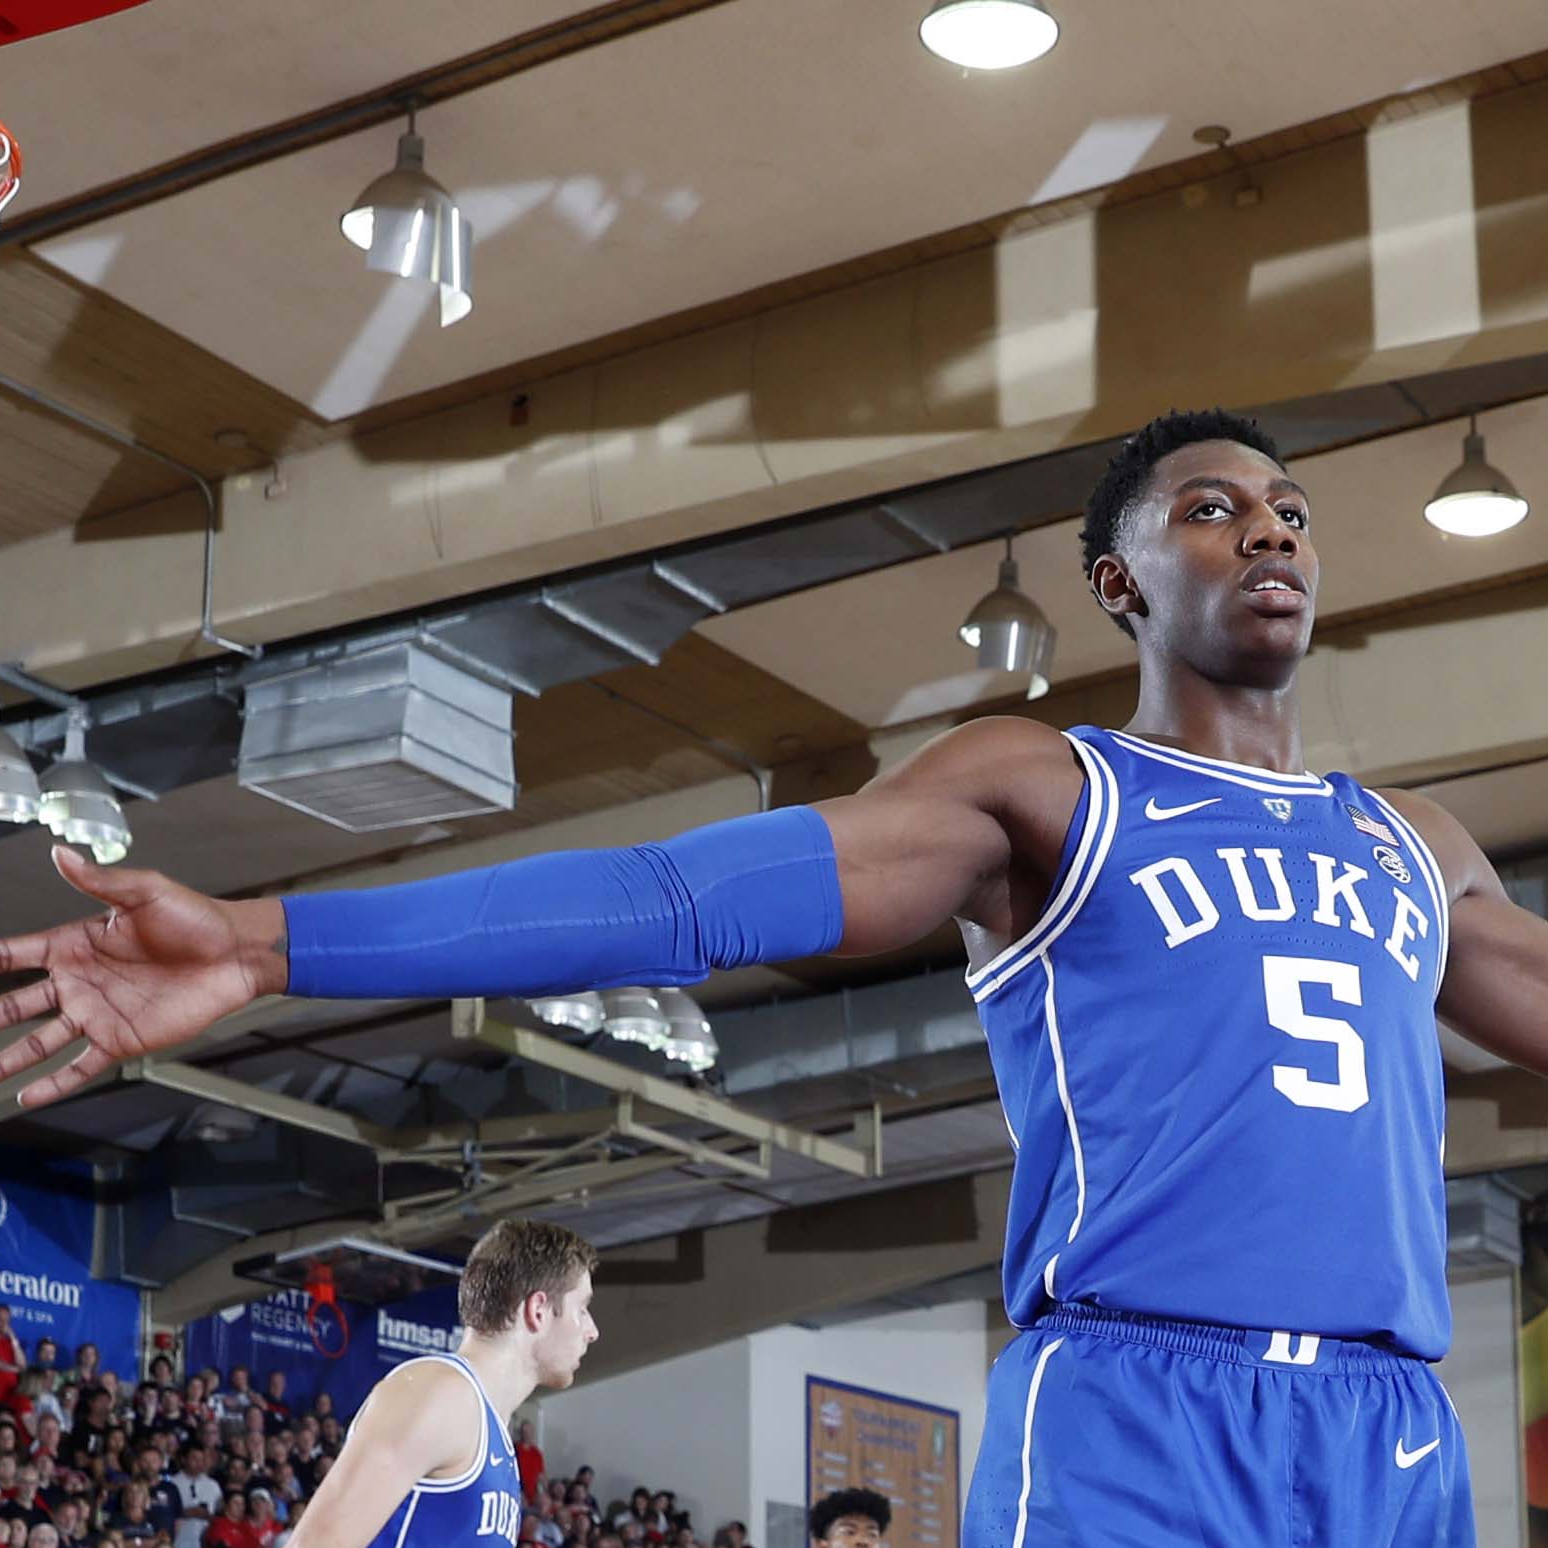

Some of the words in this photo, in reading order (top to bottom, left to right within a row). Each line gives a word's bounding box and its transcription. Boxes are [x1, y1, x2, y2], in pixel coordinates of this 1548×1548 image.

[1129, 847, 1429, 982] DUKE
[1262, 954, 1370, 1113] 5
[252, 1302, 332, 1338] REGENCY
[376, 1308, 446, 1350] hmsa
[476, 1490, 520, 1547] DUK
